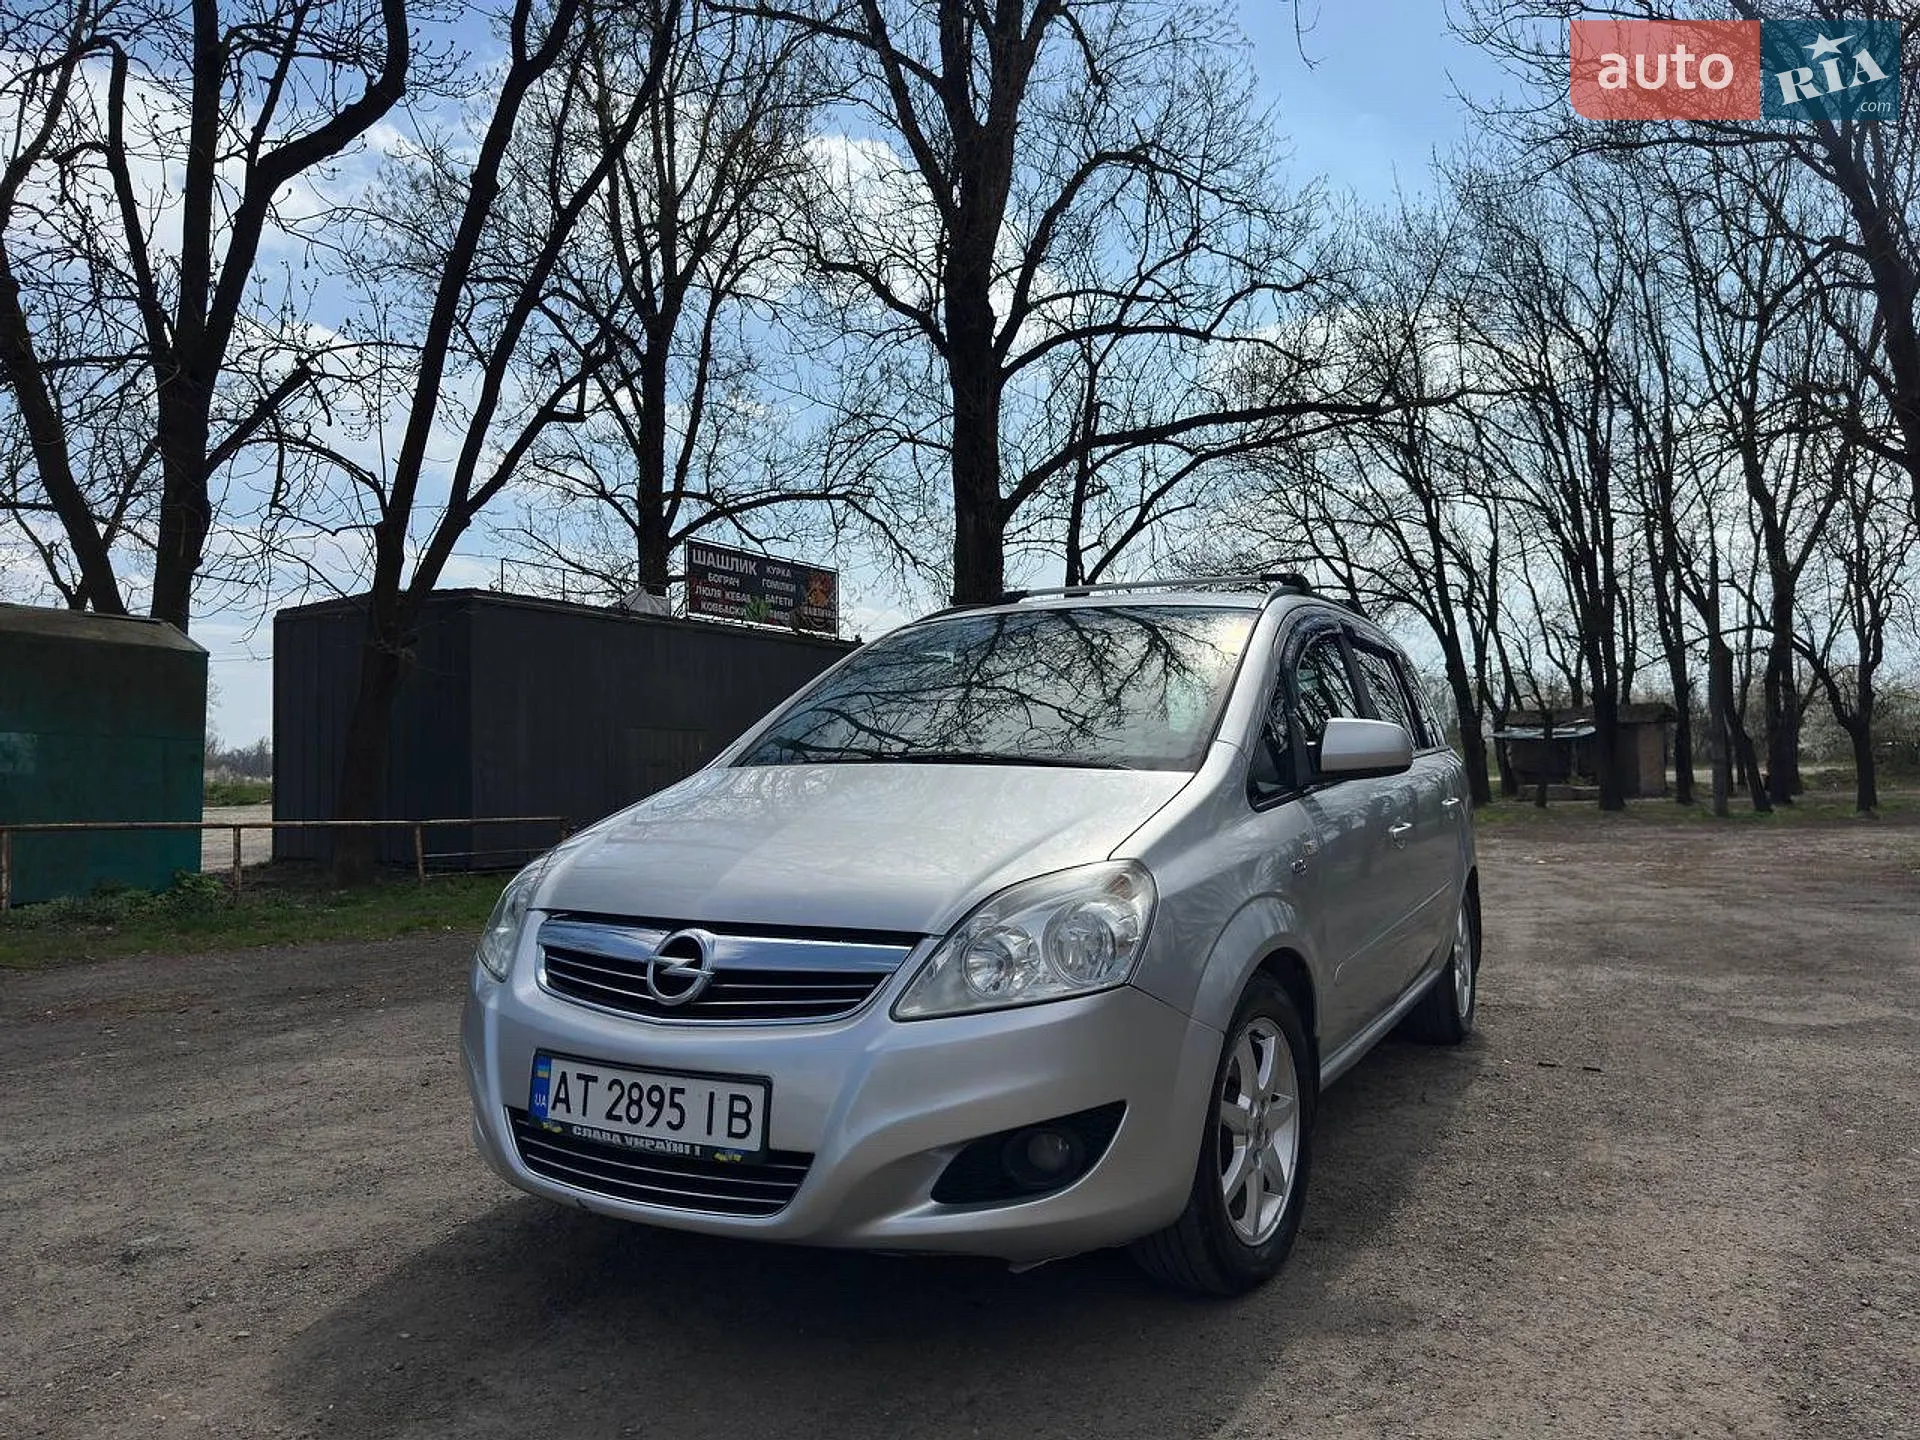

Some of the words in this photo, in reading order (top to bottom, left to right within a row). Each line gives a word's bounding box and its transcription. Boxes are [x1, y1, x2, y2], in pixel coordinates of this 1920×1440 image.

[692, 549, 758, 576] ШАШЛИК
[766, 565, 792, 578] КУРКА
[707, 572, 740, 587] БОГРАЧ
[695, 585, 722, 599] ЛЮЛЯ
[534, 1095, 547, 1107] UA
[551, 1071, 598, 1117] AT
[605, 1078, 686, 1131] 2895
[706, 1091, 753, 1139] IB
[572, 1125, 621, 1145] СЛАВА
